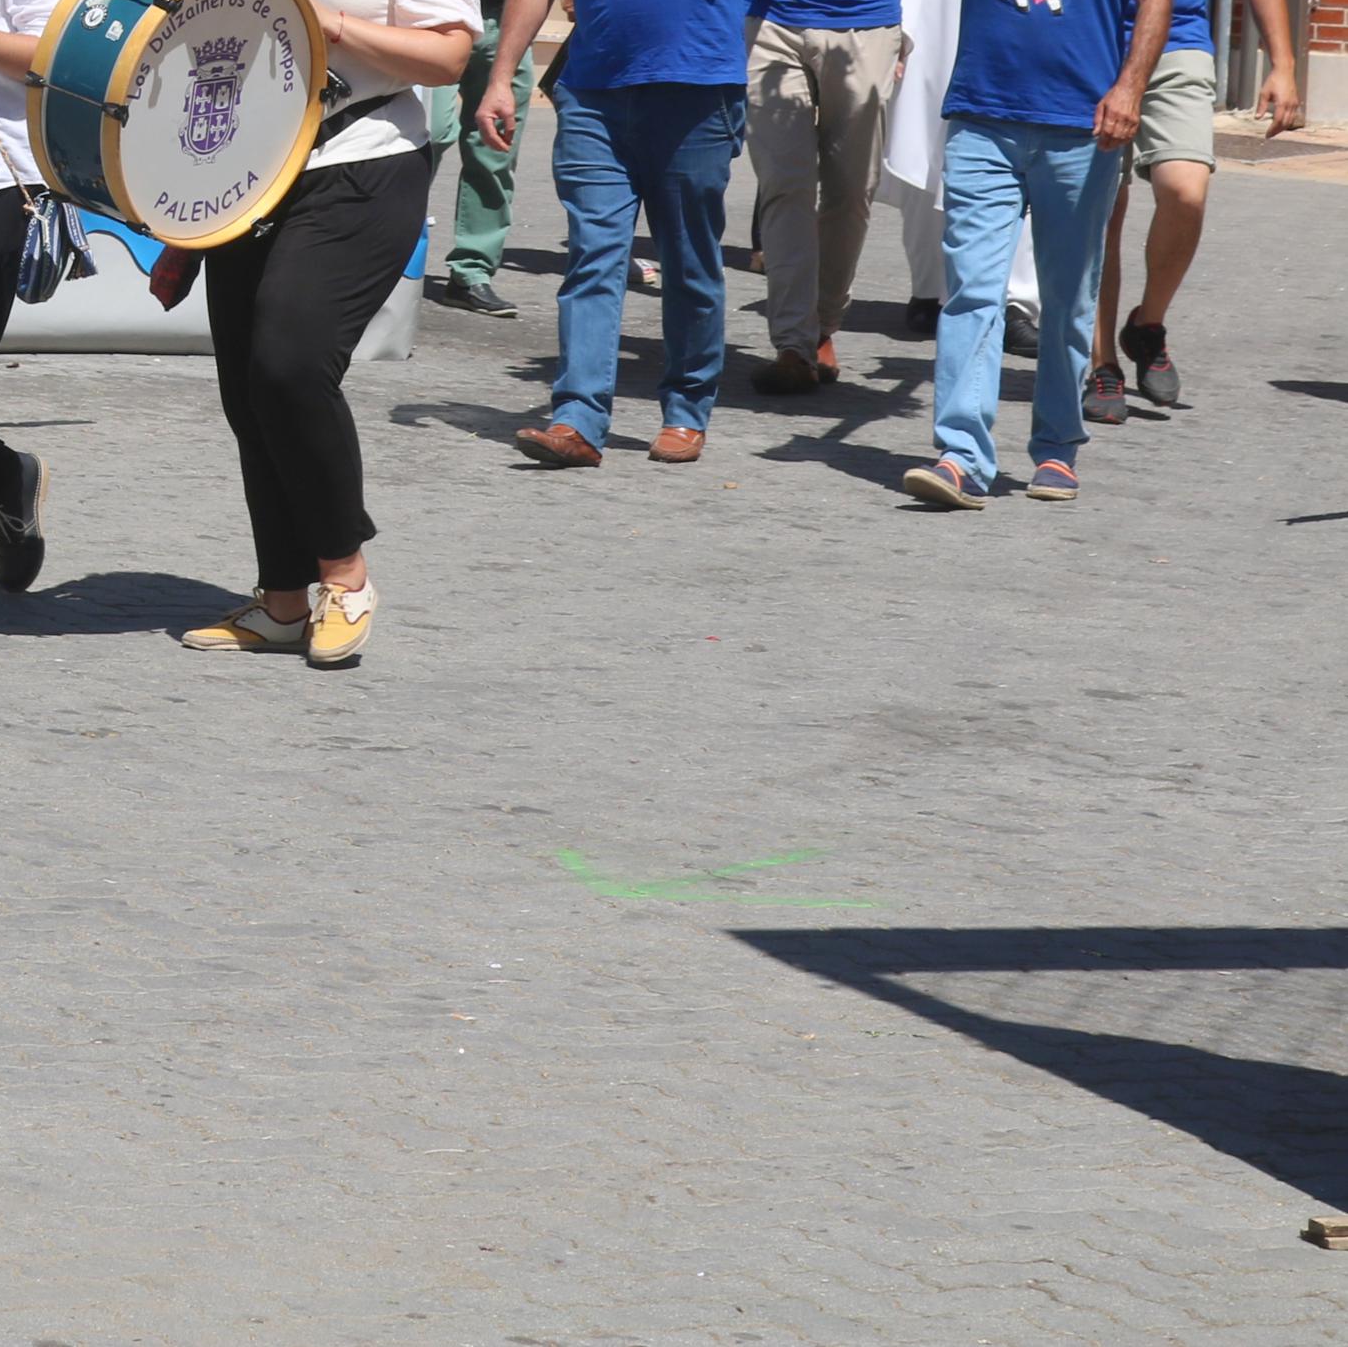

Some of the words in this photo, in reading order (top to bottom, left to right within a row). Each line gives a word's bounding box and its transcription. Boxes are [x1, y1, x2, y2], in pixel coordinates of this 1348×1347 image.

[127, 62, 150, 100] Los
[271, 16, 295, 94] Campos
[153, 168, 260, 223] PALENCIA
